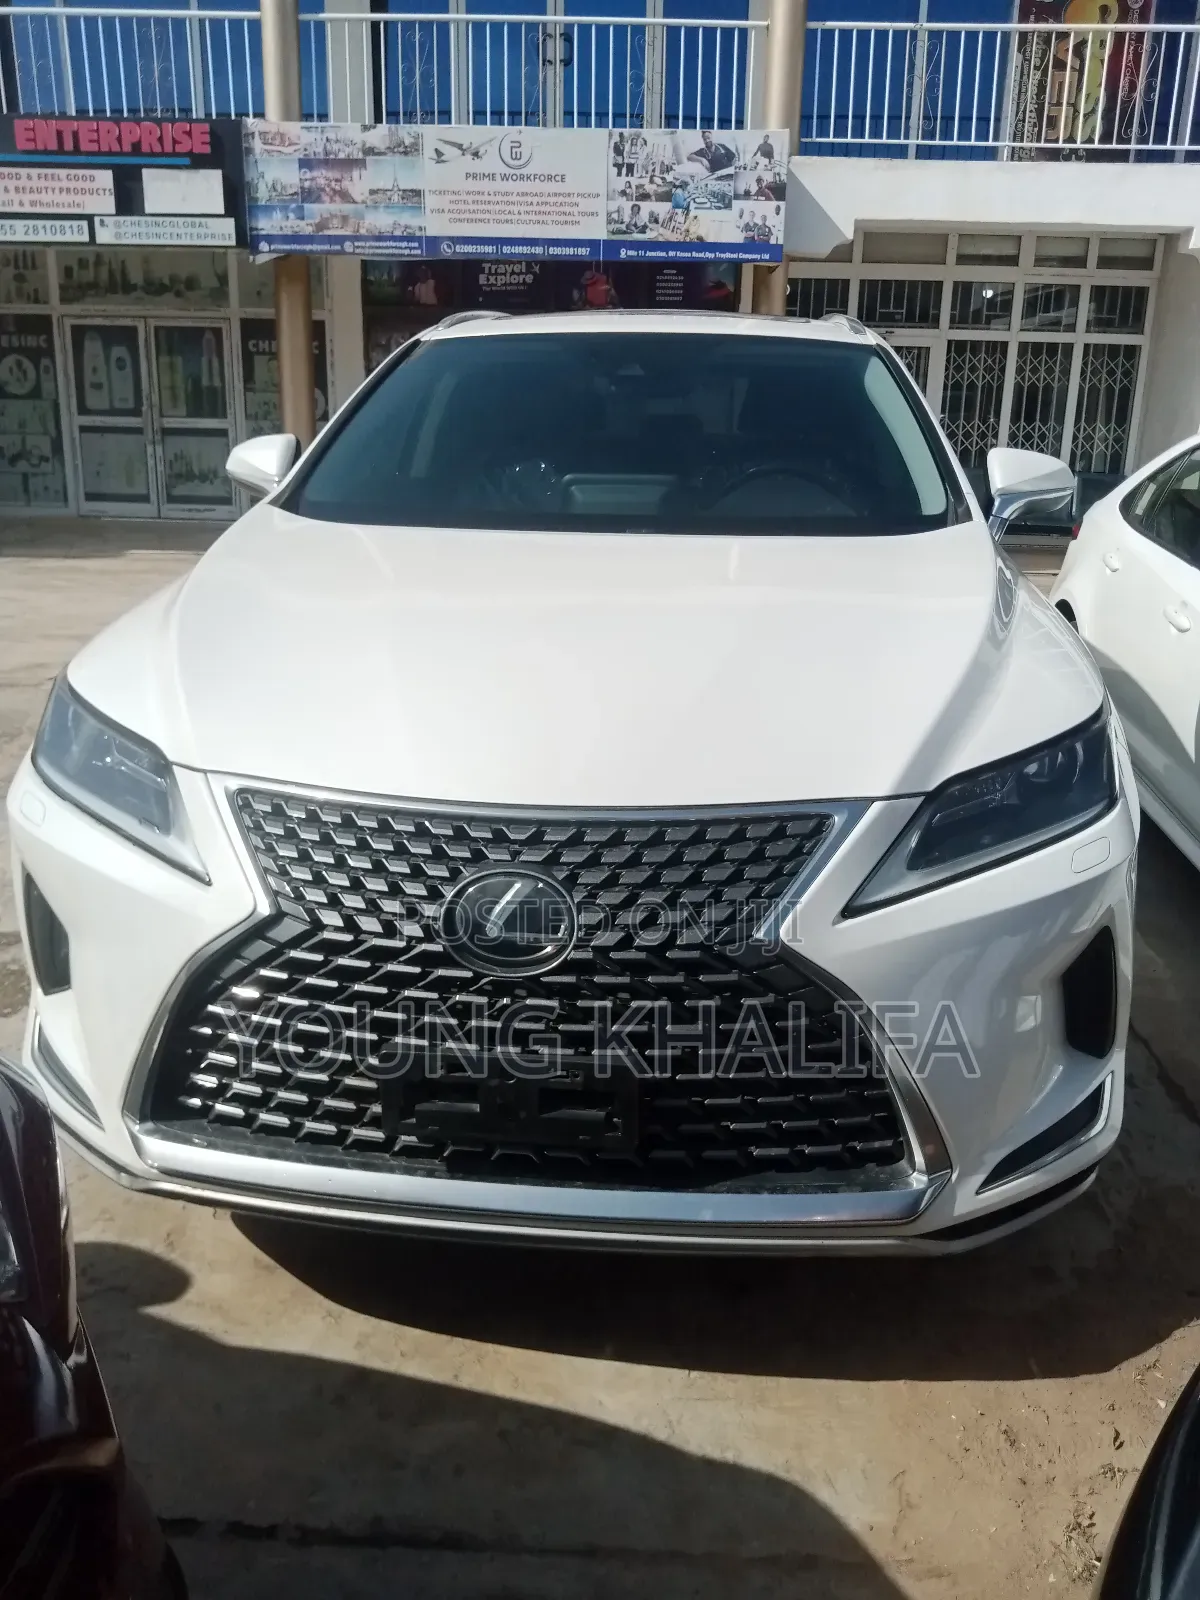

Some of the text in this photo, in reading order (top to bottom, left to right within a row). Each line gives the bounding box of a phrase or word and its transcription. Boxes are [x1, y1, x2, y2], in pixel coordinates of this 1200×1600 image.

[14, 118, 211, 154] ENTERPRISE
[0, 171, 22, 181] OOD
[37, 172, 62, 182] FEEL
[66, 173, 96, 182] GOOD
[465, 172, 566, 183] PRIME WORKFORCE
[14, 185, 56, 195] BEAUTY
[59, 187, 114, 196] PRODUCTS
[0, 223, 85, 237] 55 2810818
[113, 218, 210, 230] @CHESINCGLOBAL
[114, 230, 235, 242] @CHESINCENTERPRISE
[481, 262, 526, 274] Travel
[479, 272, 534, 286] Explore
[0, 334, 48, 348] ESINC
